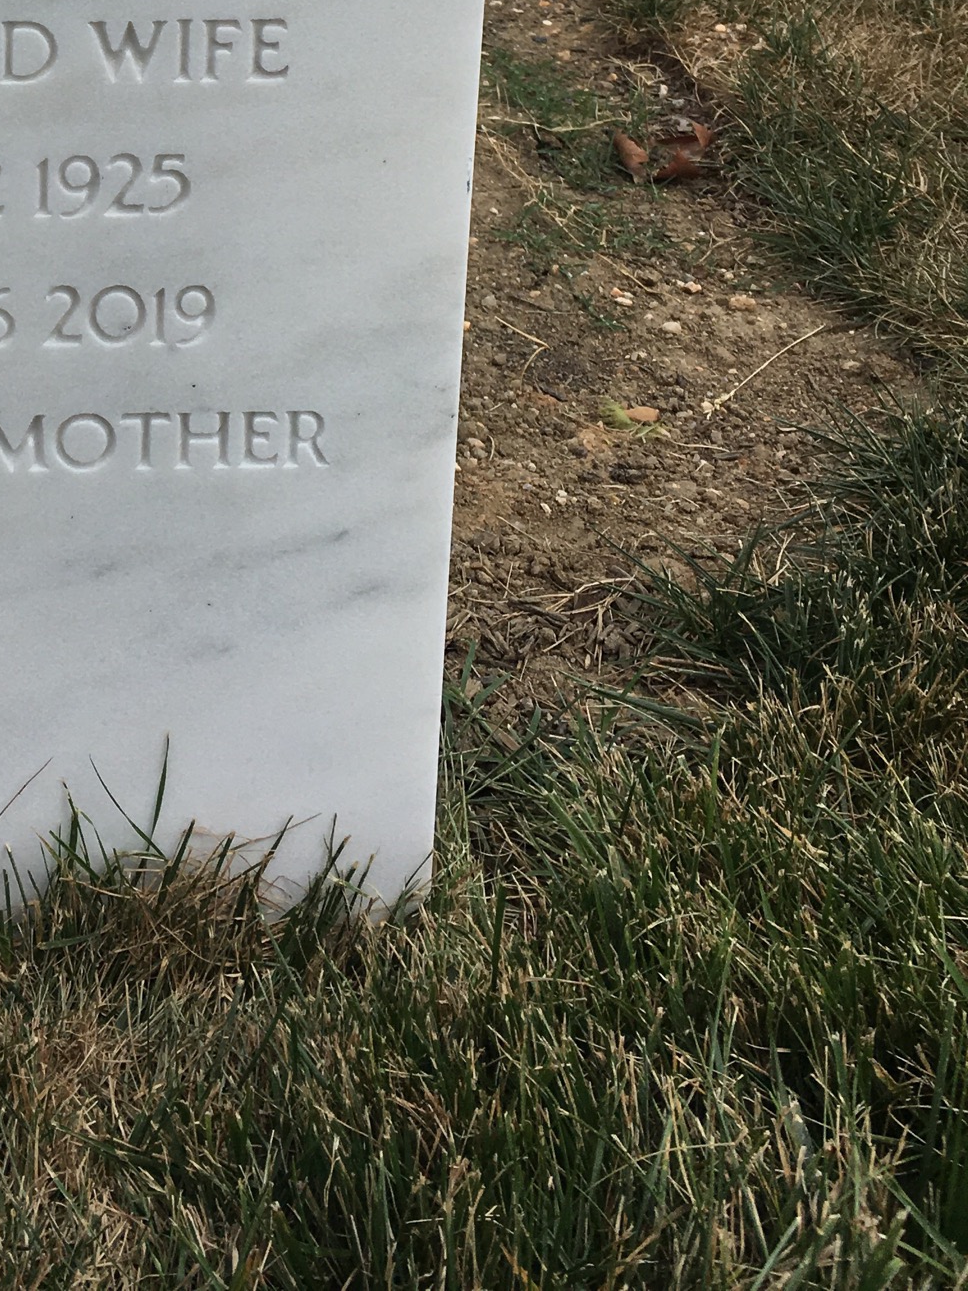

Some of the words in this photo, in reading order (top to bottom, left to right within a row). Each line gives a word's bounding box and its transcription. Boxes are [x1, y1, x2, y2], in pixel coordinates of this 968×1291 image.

[89, 17, 290, 84] WIFE
[33, 152, 193, 218] 1925
[41, 284, 216, 348] 2019
